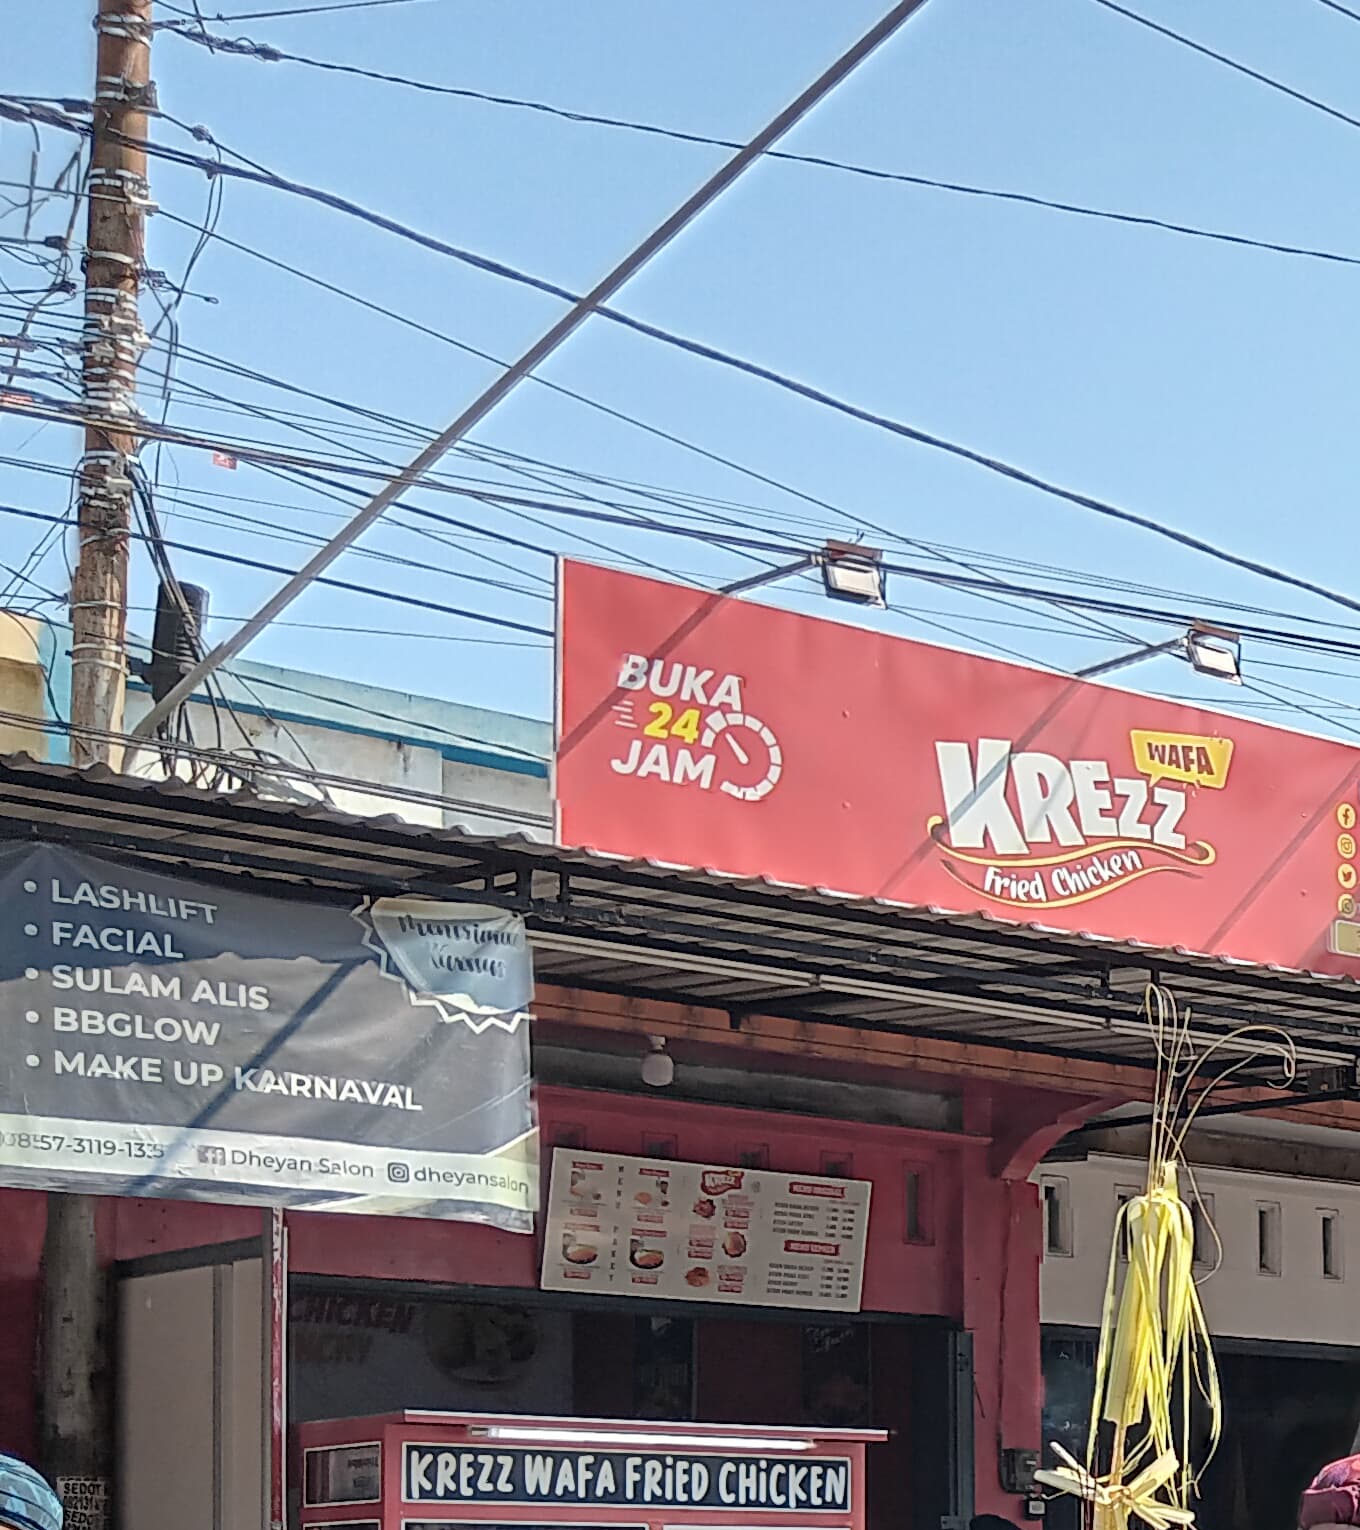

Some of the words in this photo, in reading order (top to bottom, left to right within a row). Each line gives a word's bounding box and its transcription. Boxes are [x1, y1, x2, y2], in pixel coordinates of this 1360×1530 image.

[617, 653, 743, 712] BUKA
[643, 701, 701, 745] 24
[610, 739, 717, 789] JAM
[1146, 741, 1215, 776] WAFA
[934, 737, 1187, 855] KREZZ
[983, 865, 1048, 903] Fried
[1051, 849, 1143, 897] Chicken
[51, 878, 218, 924] LASHLIFT
[51, 921, 184, 959] FACIAL
[51, 964, 181, 1001] SULAM
[191, 978, 270, 1010] ALIS
[52, 1006, 221, 1046] BBGLOW
[54, 1049, 163, 1084] MAKE
[173, 1059, 224, 1088] UP
[234, 1064, 424, 1112] KARNAVAL
[231, 1149, 312, 1175] Dheyan
[318, 1158, 374, 1179] Salon
[414, 1166, 530, 1195] dheyansalon
[63, 1482, 102, 1495] SEDOT
[410, 1450, 515, 1499] KREZZ
[523, 1453, 616, 1498] WAFA
